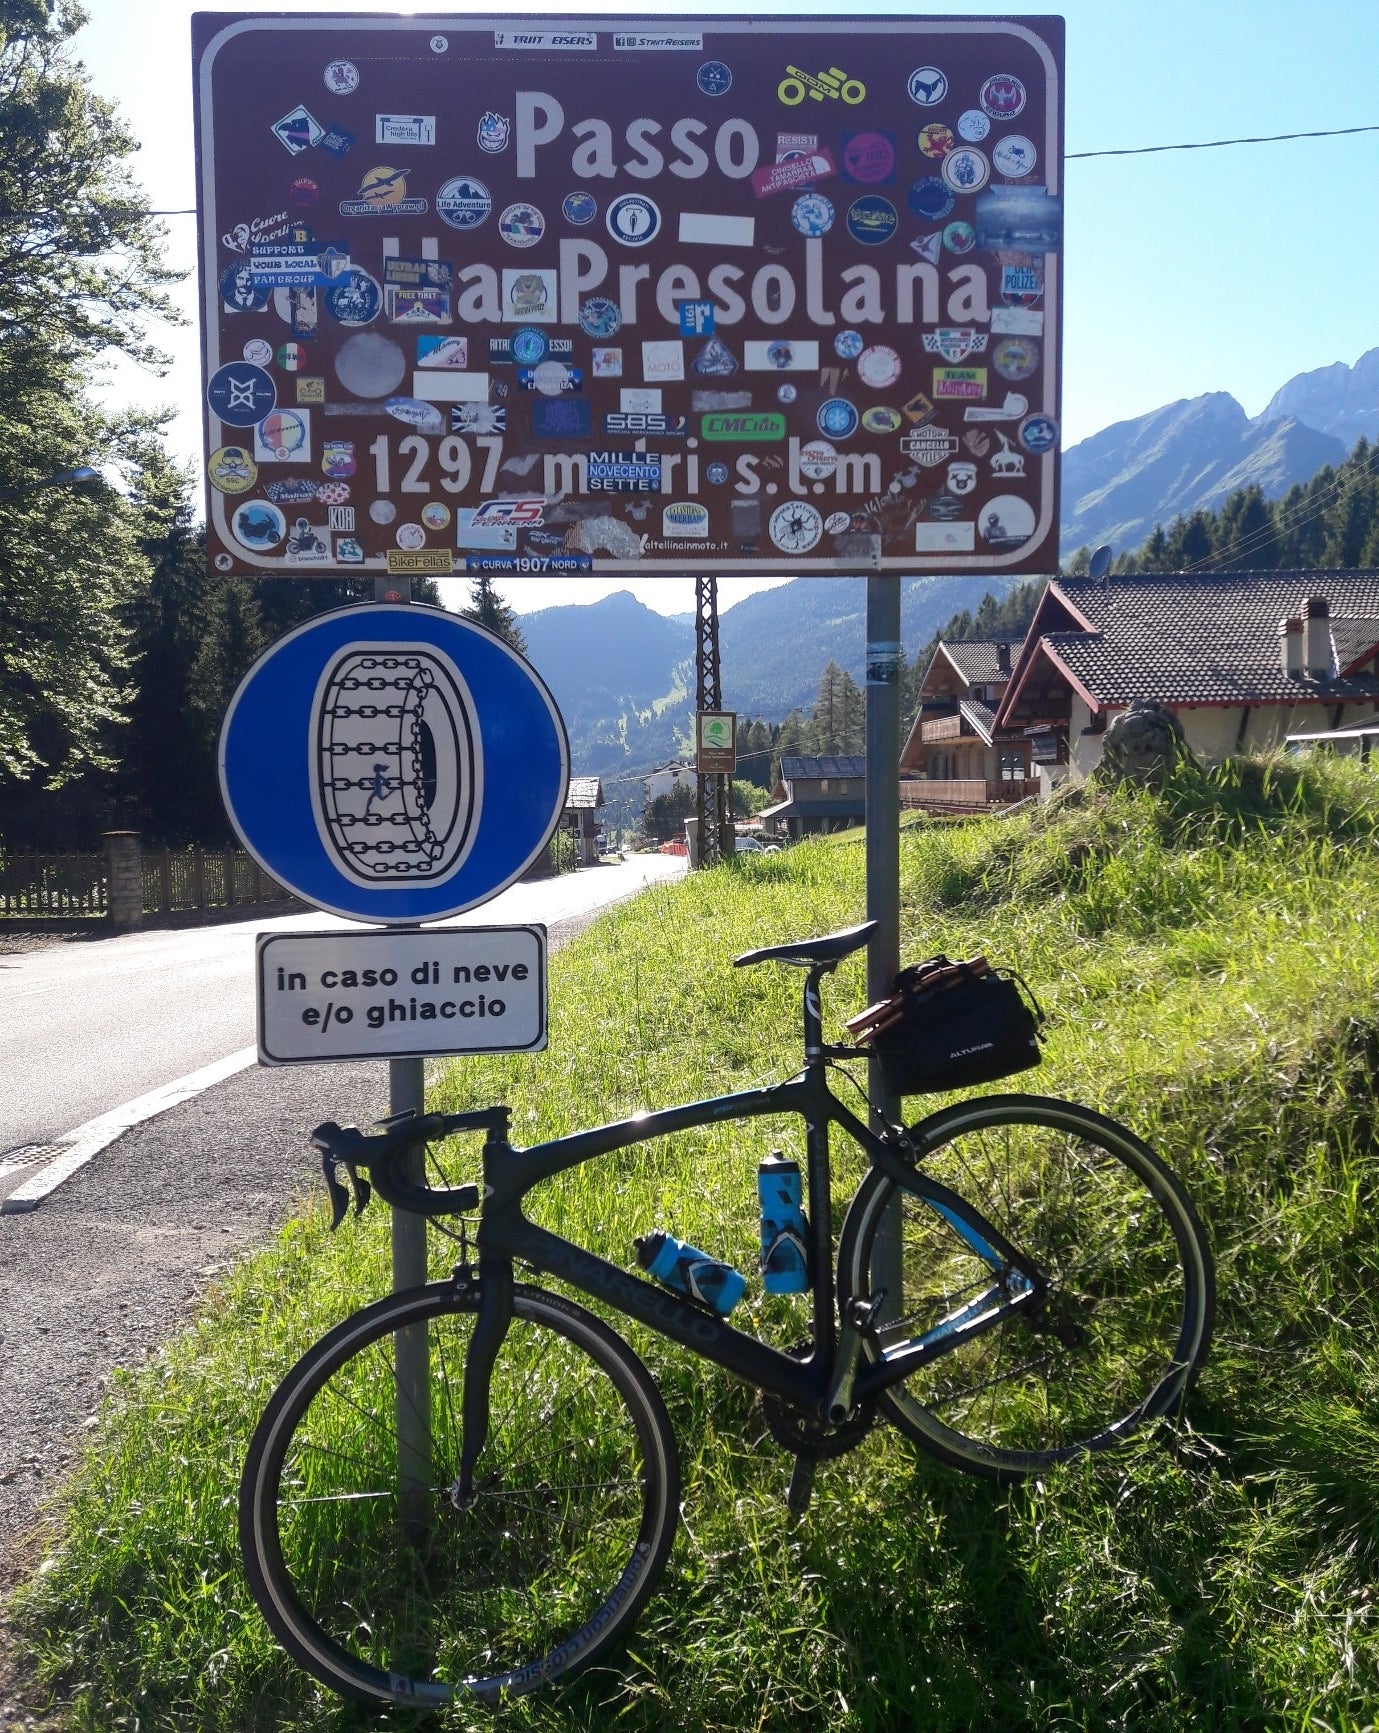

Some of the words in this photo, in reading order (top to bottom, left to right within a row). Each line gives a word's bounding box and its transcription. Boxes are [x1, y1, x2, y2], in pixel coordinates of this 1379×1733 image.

[515, 90, 760, 179] Passo
[437, 200, 451, 209] Life
[452, 200, 491, 209] Adventure
[250, 210, 289, 233] Cuore
[252, 245, 305, 255] SUPPORT
[252, 259, 283, 270] YOUR
[284, 259, 317, 269] LOCAL
[254, 275, 276, 285] FAN
[277, 274, 316, 284] GROUP
[559, 238, 992, 326] Presolana
[398, 292, 417, 300] FREE
[417, 292, 437, 300] TIBET
[909, 439, 950, 450] CANCELLO
[368, 434, 504, 494] 1297
[544, 436, 699, 496] mri
[589, 451, 661, 465] MILLE
[588, 464, 660, 478] NOVECENTO
[590, 478, 650, 491] SETTE
[389, 554, 452, 568] BikeFellas
[482, 559, 513, 569] CURVA
[514, 557, 550, 572] 1907
[551, 559, 577, 569] NORD
[276, 967, 307, 991] in
[320, 967, 398, 989] caso
[410, 961, 441, 985] di
[453, 962, 529, 985] neve
[301, 1001, 355, 1034] e/o
[366, 994, 506, 1029] ghiaccio
